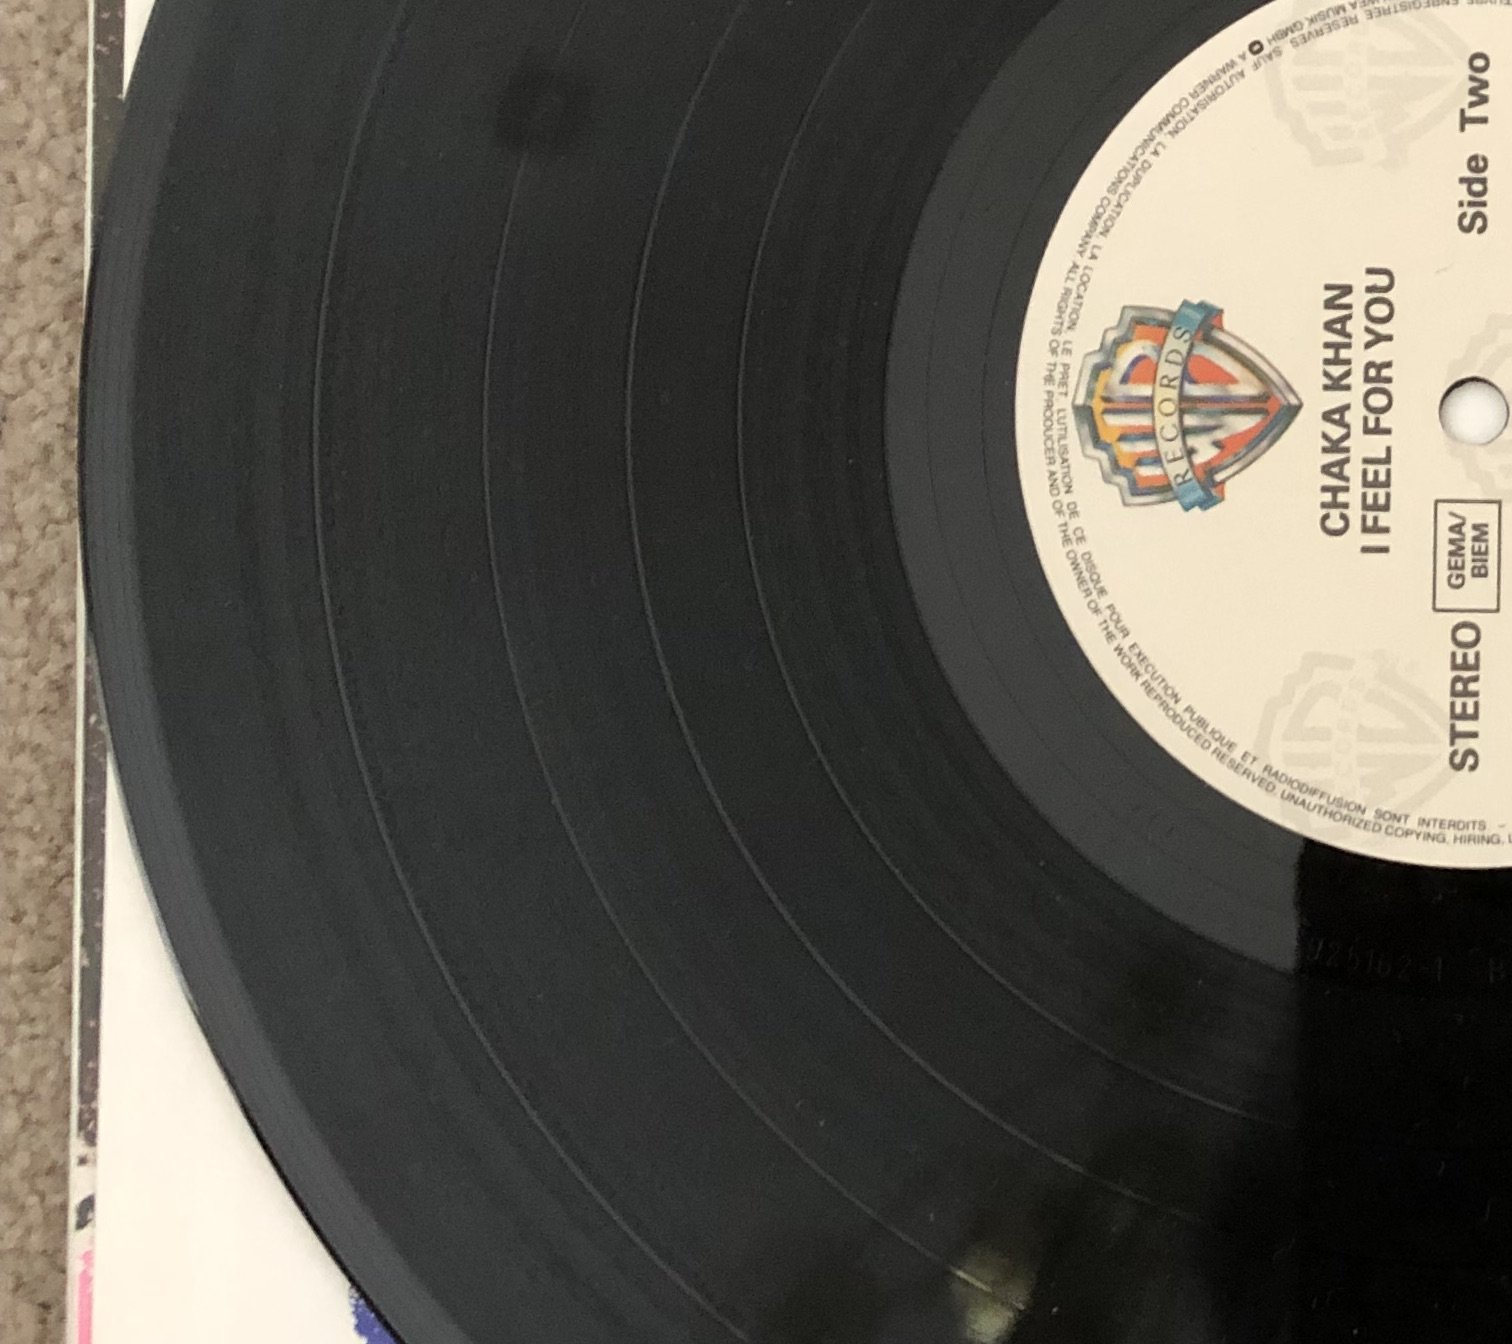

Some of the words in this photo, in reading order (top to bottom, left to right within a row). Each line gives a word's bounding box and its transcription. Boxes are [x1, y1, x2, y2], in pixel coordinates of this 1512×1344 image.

[1459, 52, 1490, 133] Two
[1457, 154, 1488, 235] Side
[1322, 284, 1353, 392] KHAN
[1364, 268, 1395, 350] YOU
[1157, 325, 1193, 487] RECORDS
[1362, 361, 1393, 436] FOR
[1320, 403, 1351, 537] CHAKA
[1361, 446, 1392, 534] FEEL
[1360, 546, 1390, 554] I
[1447, 512, 1466, 590] GEMA/
[1471, 523, 1489, 578] BIEM
[1448, 621, 1481, 772] STEREO
